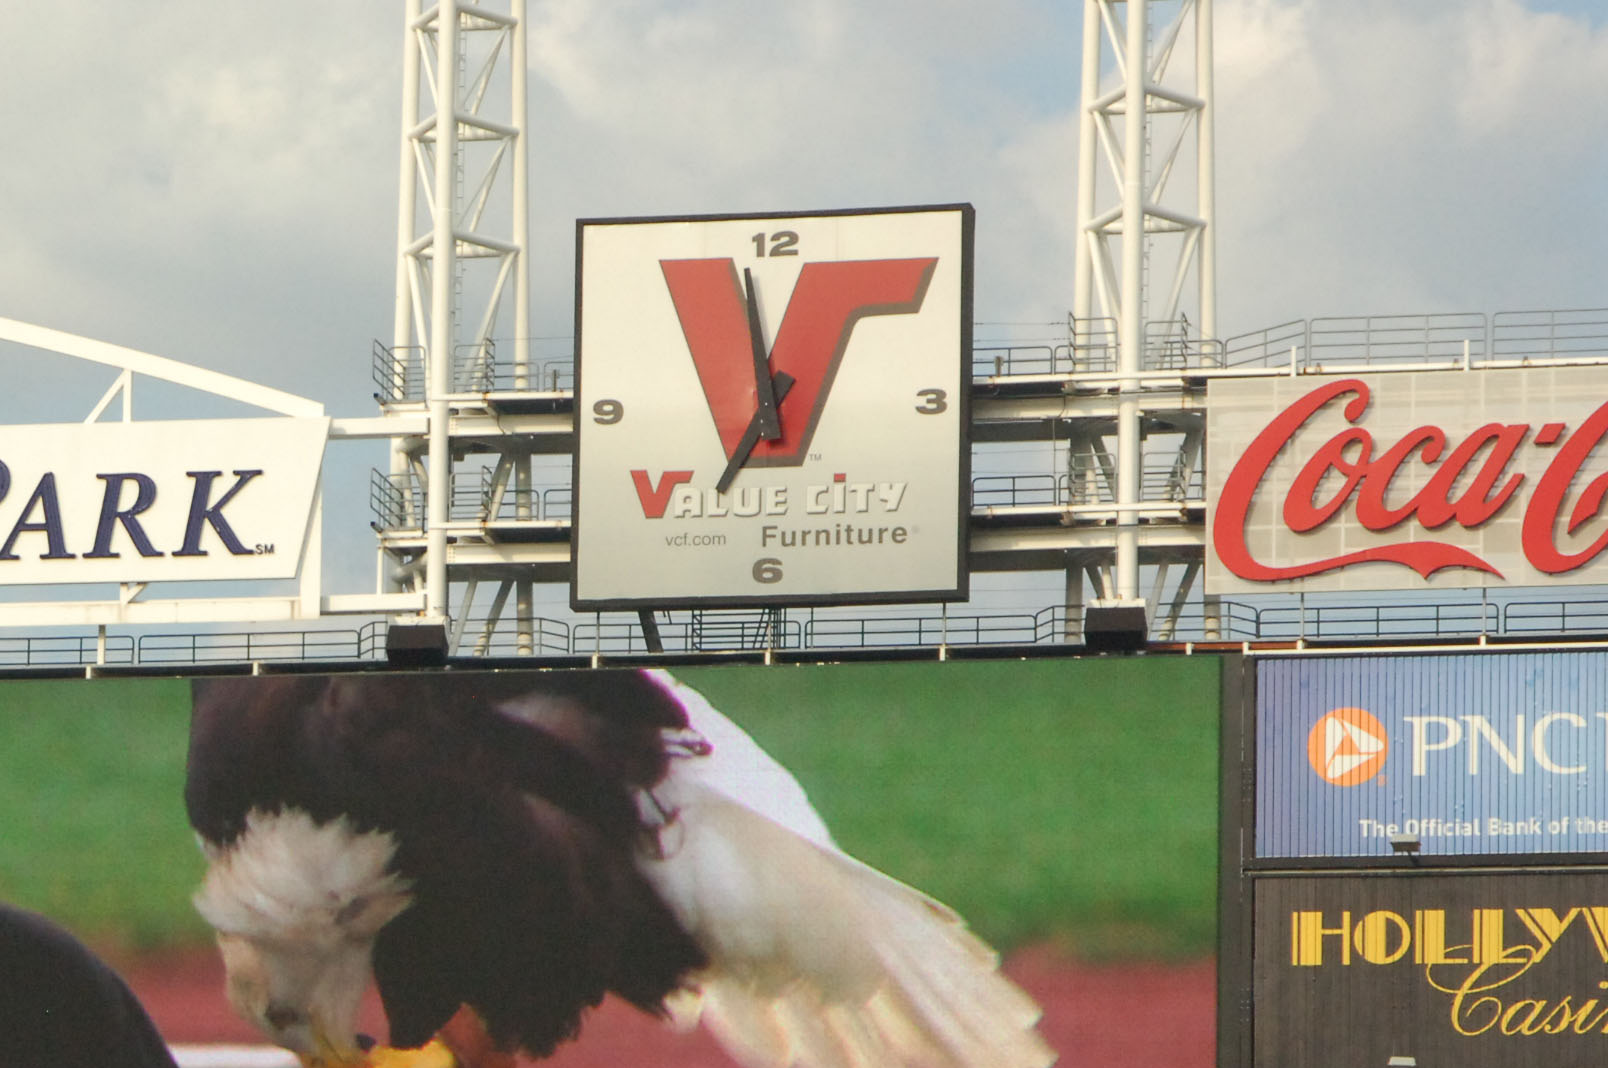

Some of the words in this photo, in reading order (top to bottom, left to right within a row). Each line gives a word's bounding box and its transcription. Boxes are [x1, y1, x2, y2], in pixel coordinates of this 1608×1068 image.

[752, 231, 800, 258] 12
[593, 400, 624, 425] 9
[915, 388, 948, 415] 3
[630, 469, 789, 519] VALUE
[665, 533, 727, 547] vcf.com
[761, 524, 908, 548] Furniture
[752, 558, 783, 584] 6
[1403, 712, 1588, 777] PNC
[1359, 818, 1399, 838] The
[1405, 817, 1481, 837] Official
[1487, 816, 1541, 836] Bank
[1548, 816, 1570, 835] of
[1574, 816, 1608, 835] the
[1426, 944, 1608, 1036] Casi
